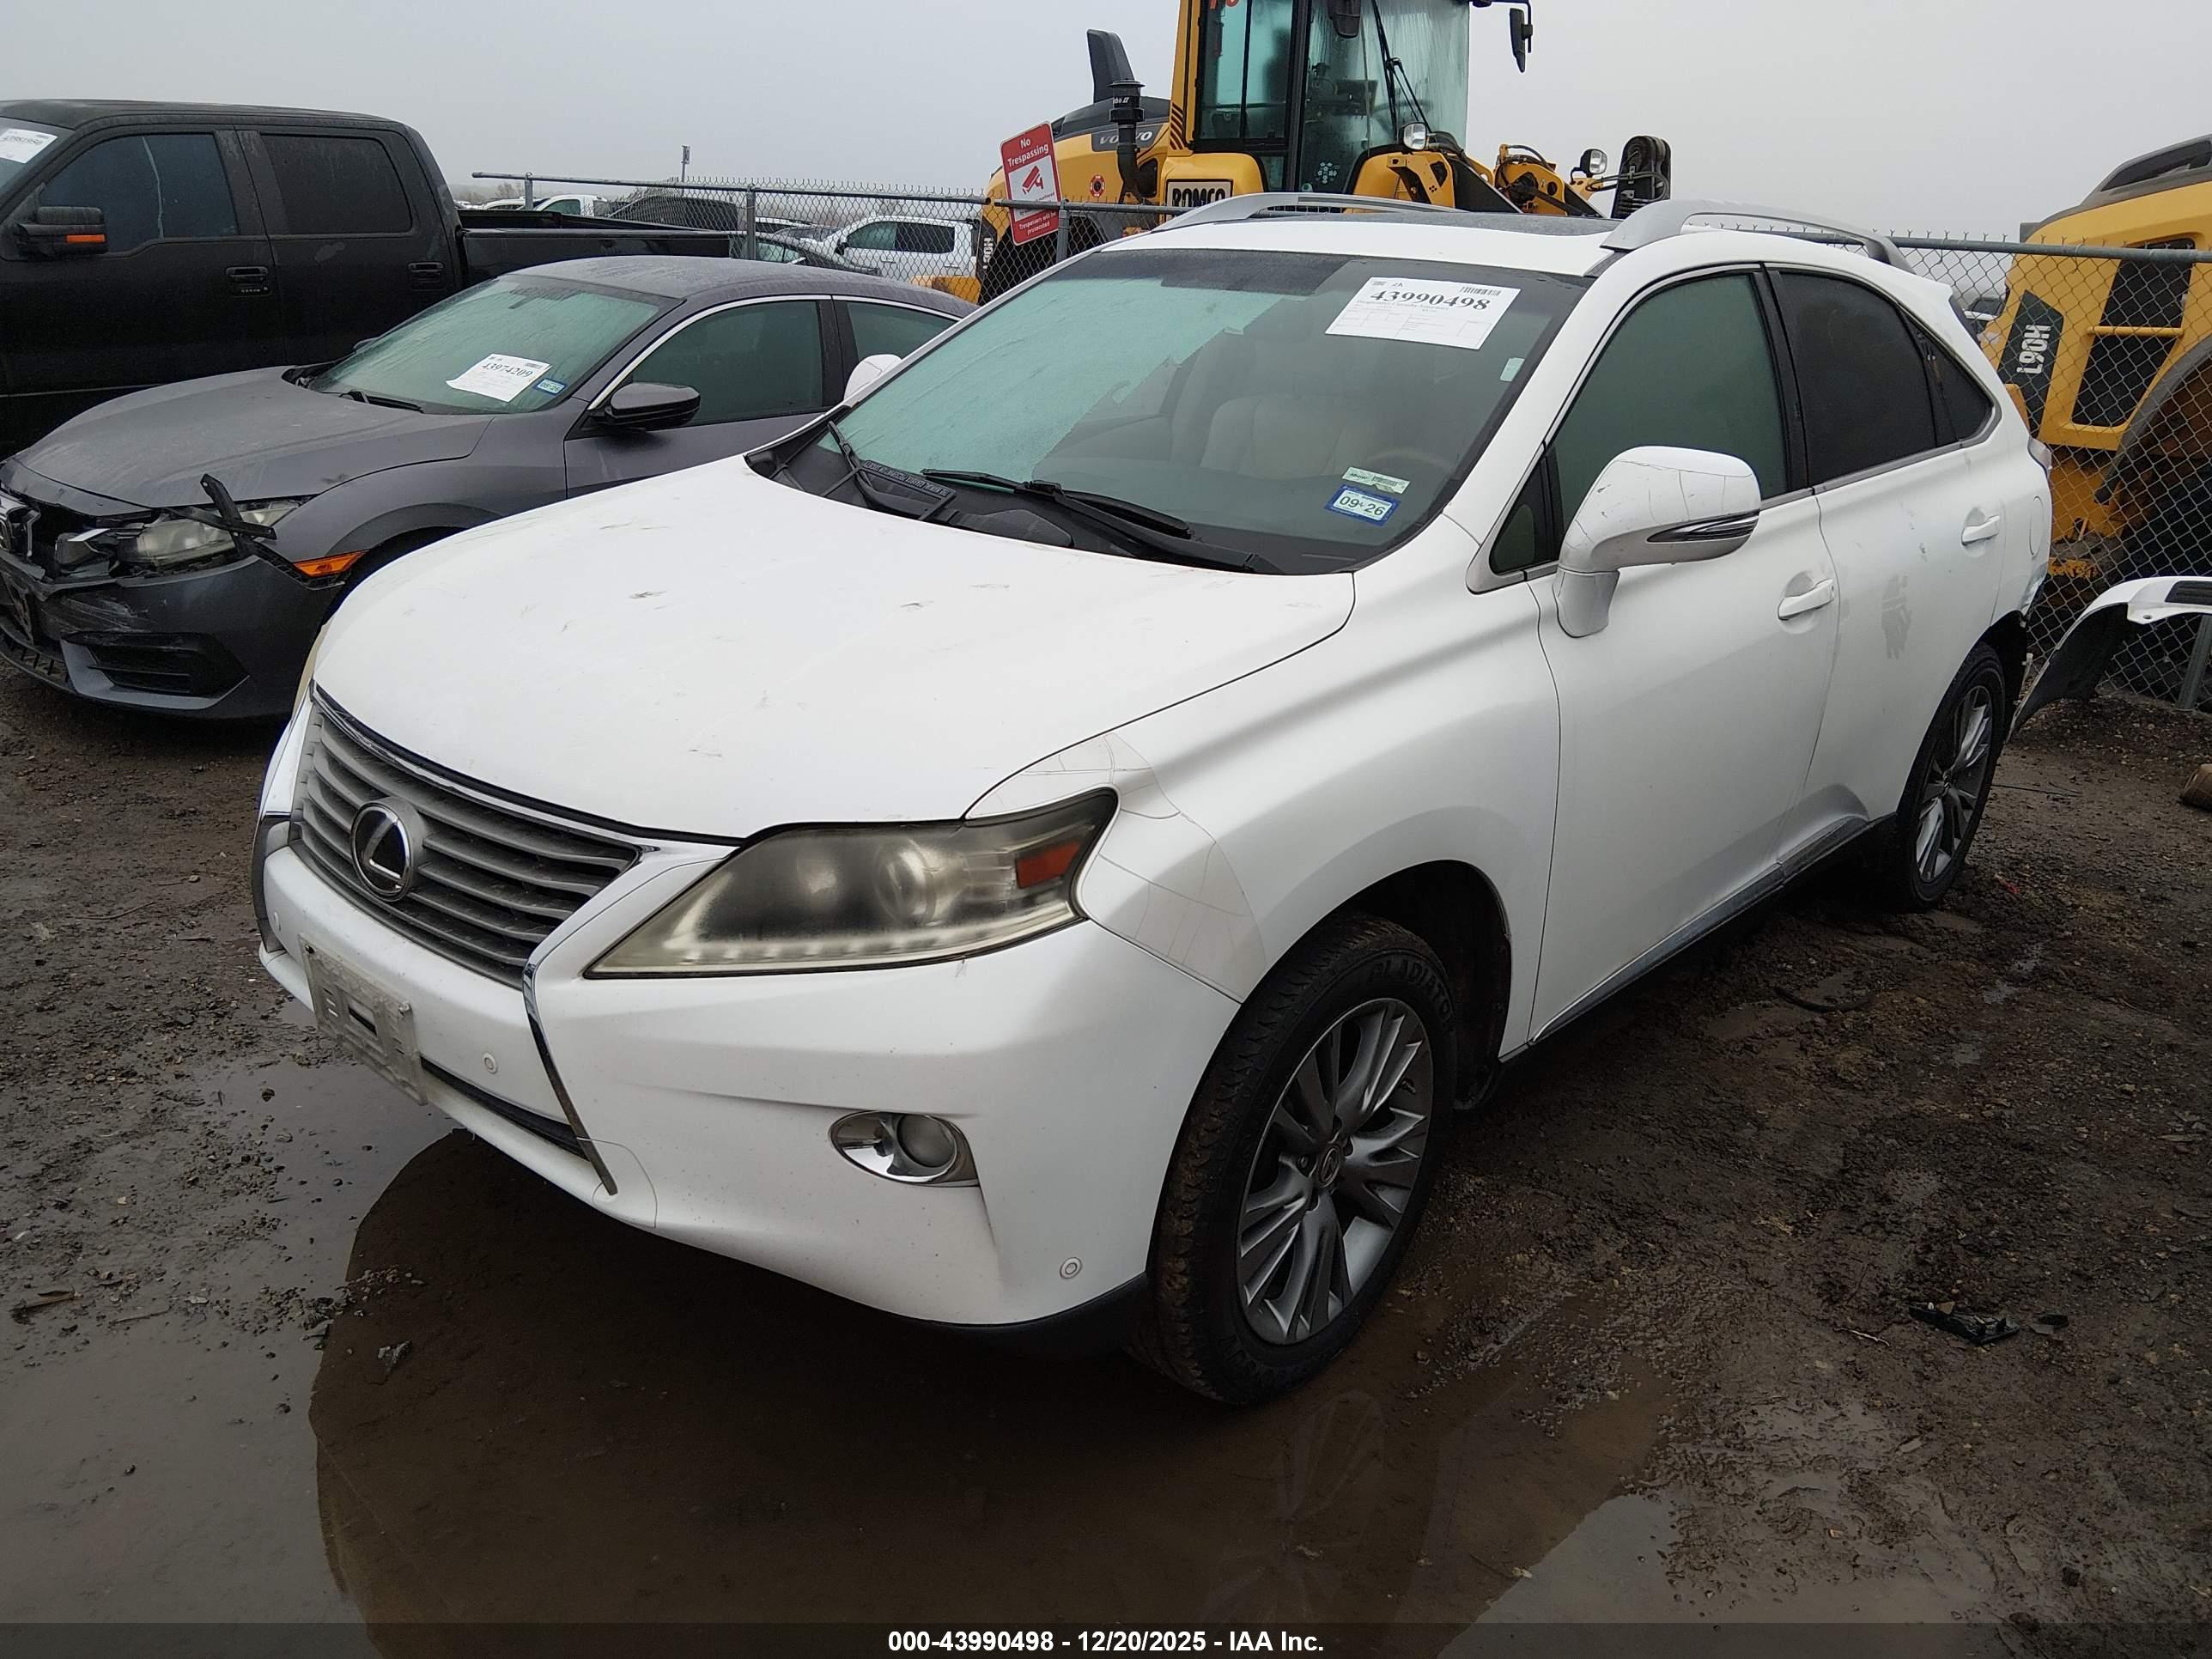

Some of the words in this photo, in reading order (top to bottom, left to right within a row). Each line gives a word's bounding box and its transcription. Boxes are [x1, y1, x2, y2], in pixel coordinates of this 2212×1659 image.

[1020, 137, 1030, 149] No
[1100, 131, 1153, 145] VOVO
[1007, 143, 1049, 167] Trespassing
[1370, 289, 1491, 311] 43990498
[2016, 325, 2051, 374] L90H
[1340, 495, 1359, 508] 09
[1364, 503, 1386, 515] 26
